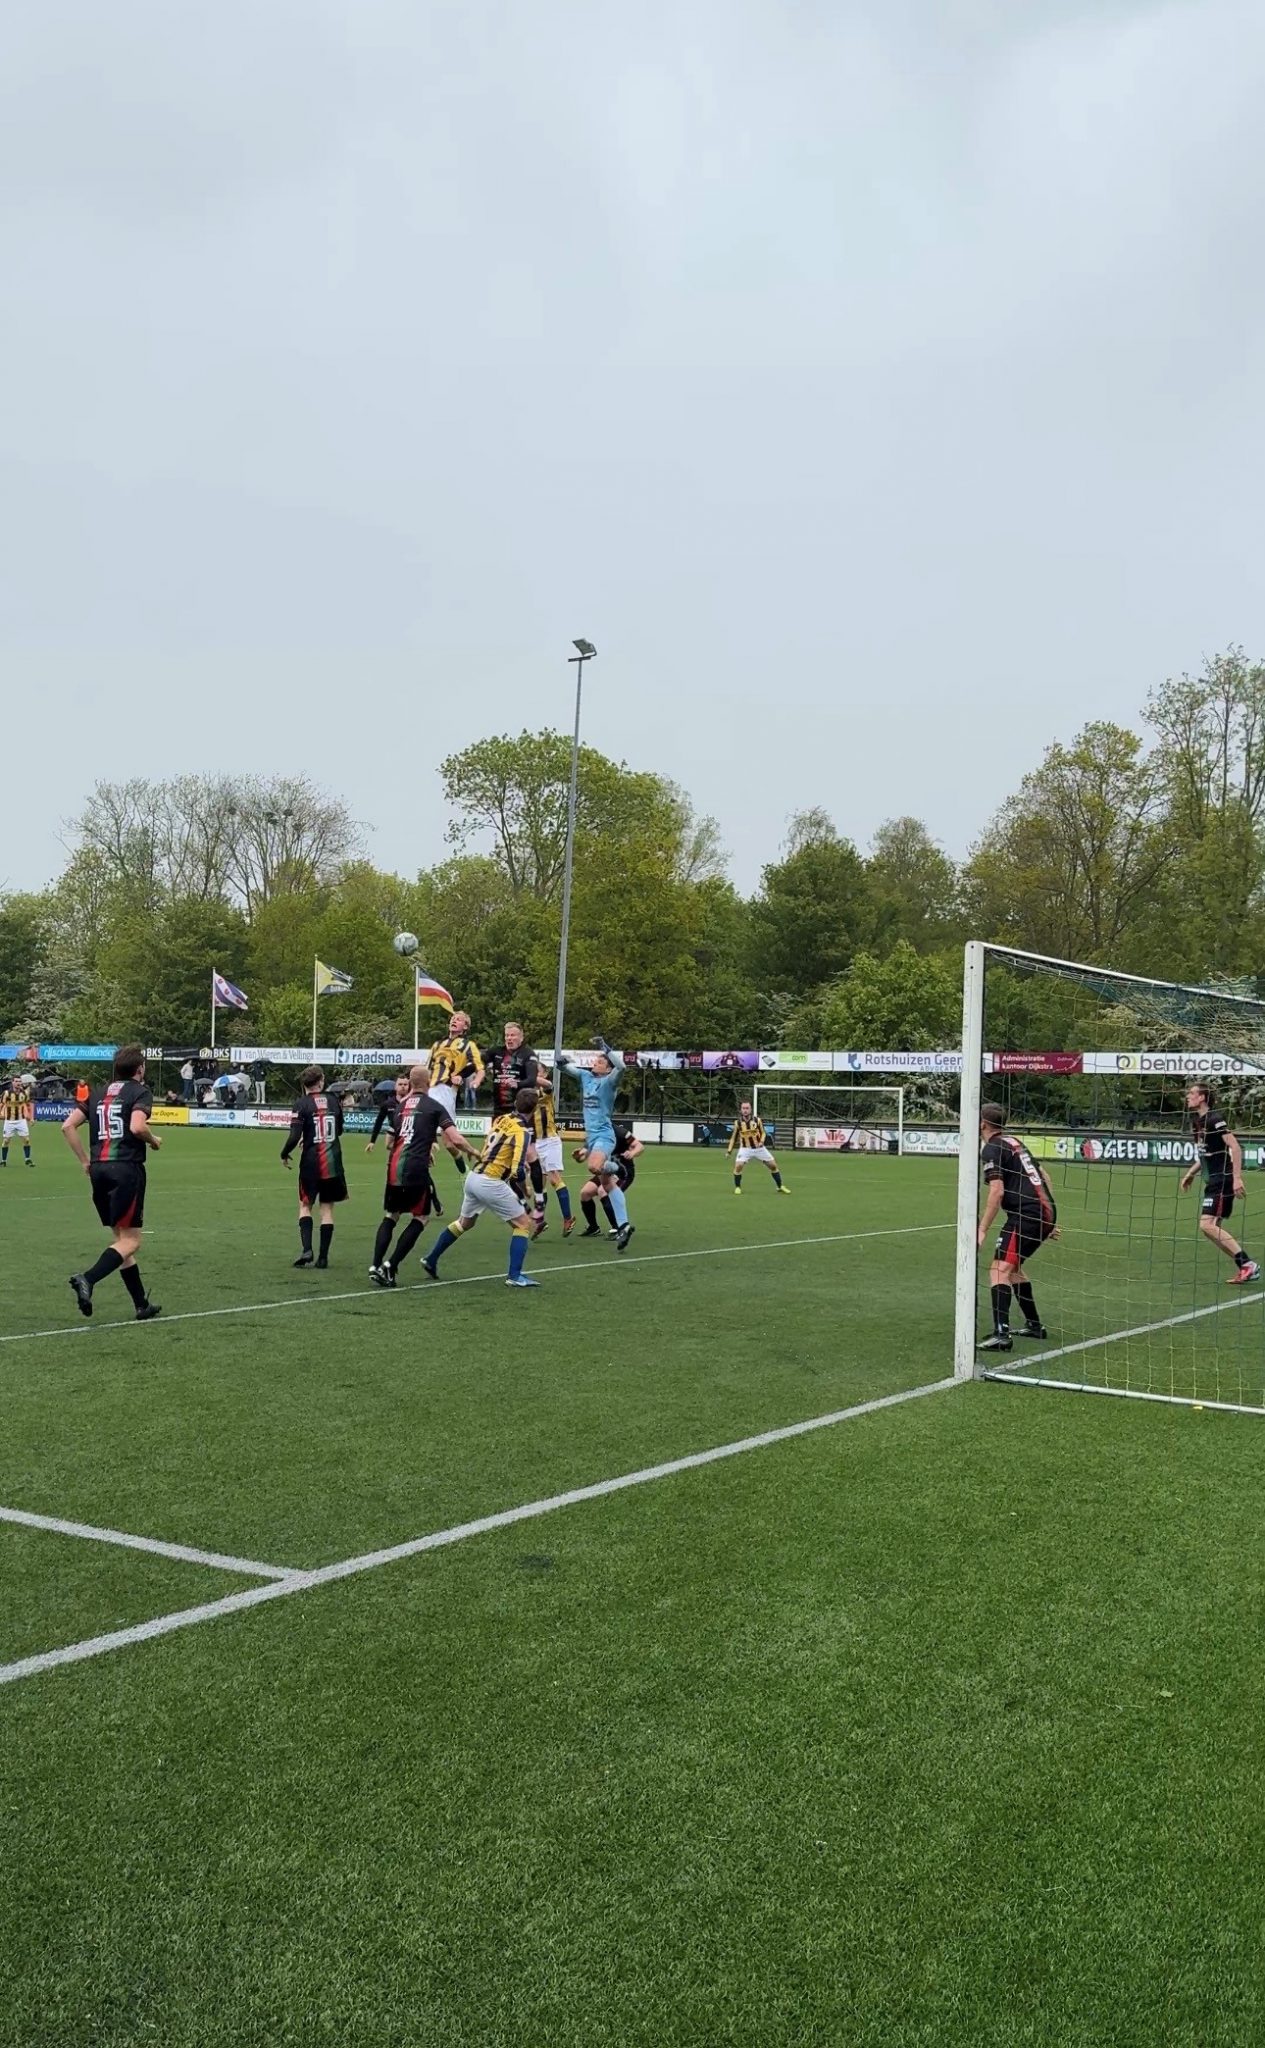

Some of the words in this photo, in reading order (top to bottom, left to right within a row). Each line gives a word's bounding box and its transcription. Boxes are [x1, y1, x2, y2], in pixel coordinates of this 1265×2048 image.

[146, 1048, 162, 1058] BKS
[213, 1048, 230, 1058] BKS
[352, 1051, 402, 1064] raadsma
[865, 1053, 931, 1066] Rotshuizen
[1028, 1063, 1054, 1071] Dijkstra
[1140, 1055, 1244, 1072] bentacera
[96, 1104, 124, 1141] 15
[313, 1115, 336, 1144] 10
[1103, 1139, 1148, 1159] GEEN
